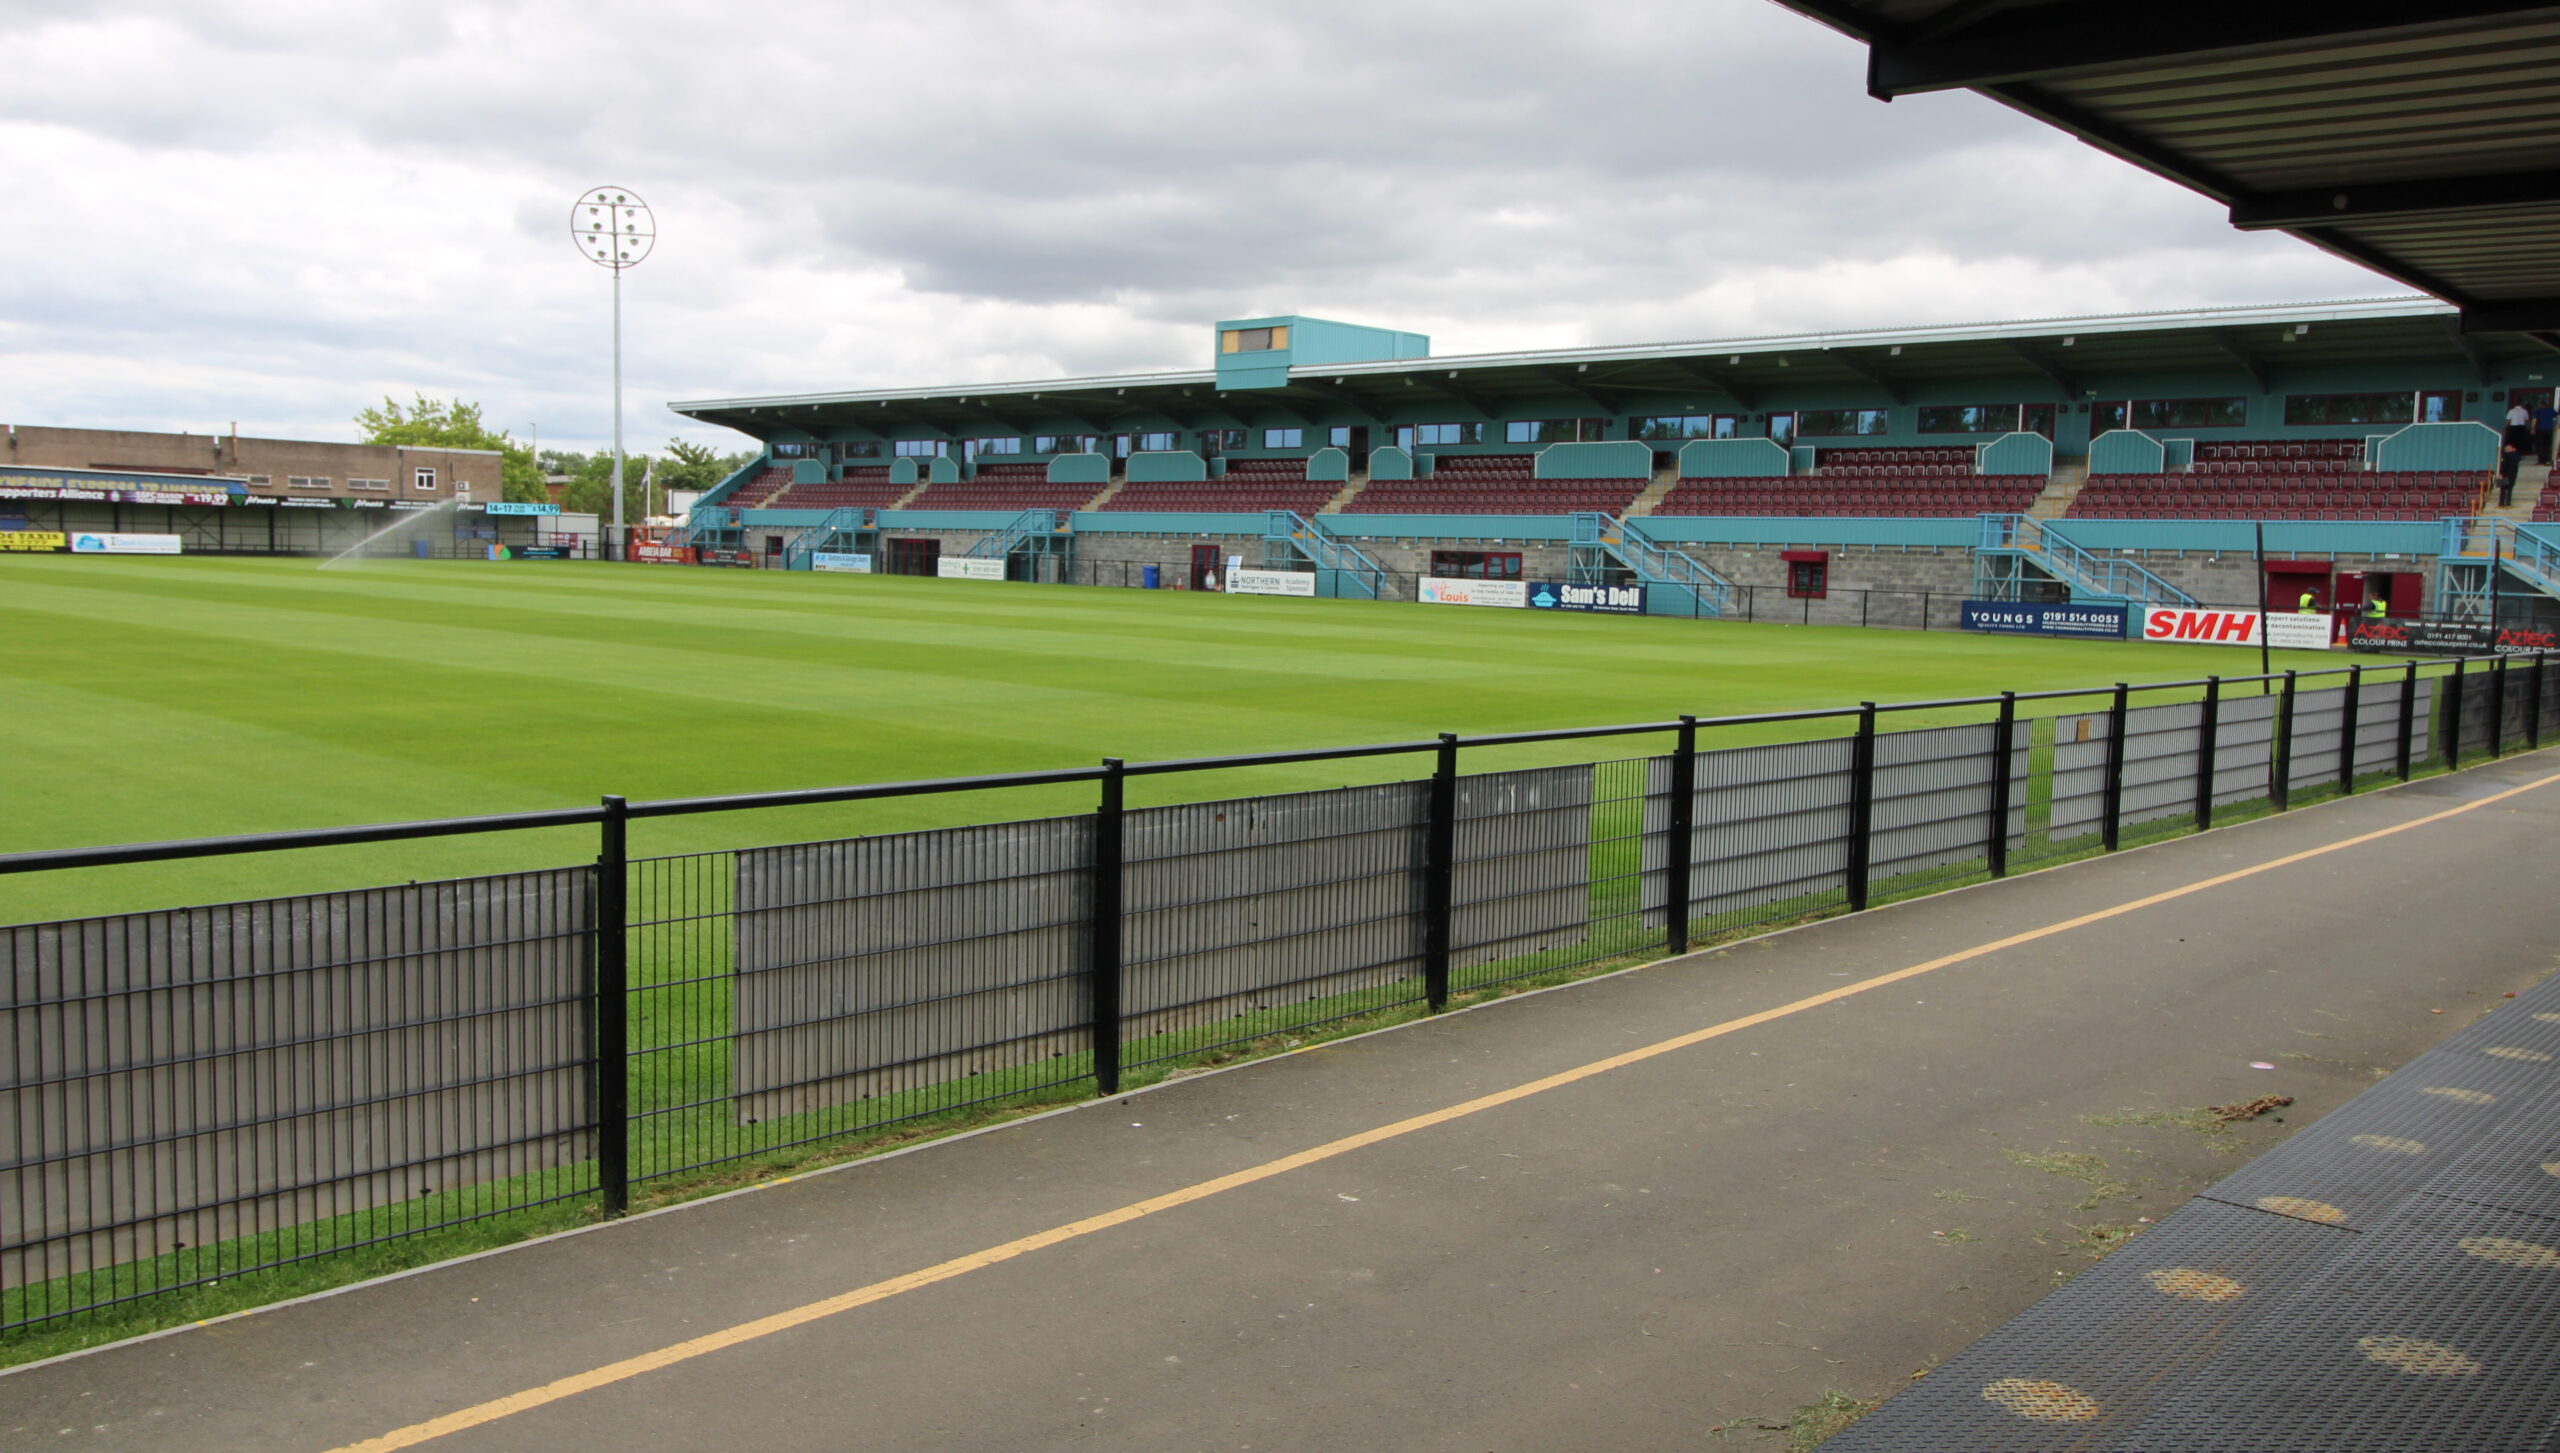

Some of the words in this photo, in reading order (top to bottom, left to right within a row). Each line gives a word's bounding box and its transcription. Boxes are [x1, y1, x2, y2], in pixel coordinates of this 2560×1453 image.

[59, 488, 104, 499] Alliance
[660, 547, 672, 557] BAR
[1241, 576, 1280, 585] NORTHERN
[1440, 591, 1469, 602] Louis
[1561, 584, 1606, 605] Sam's
[1608, 587, 1640, 606] Deli
[1971, 612, 2033, 624] YOUNGS
[2042, 612, 2066, 621] 0191
[2069, 613, 2087, 622] 514
[2090, 614, 2119, 624] 0053
[2144, 610, 2257, 642] SMH
[2352, 622, 2409, 640] Aztec
[2352, 637, 2386, 646] COLOUR
[2387, 639, 2408, 648] PRINT
[2495, 627, 2557, 647] Aztec
[2494, 644, 2532, 653] COLOUR
